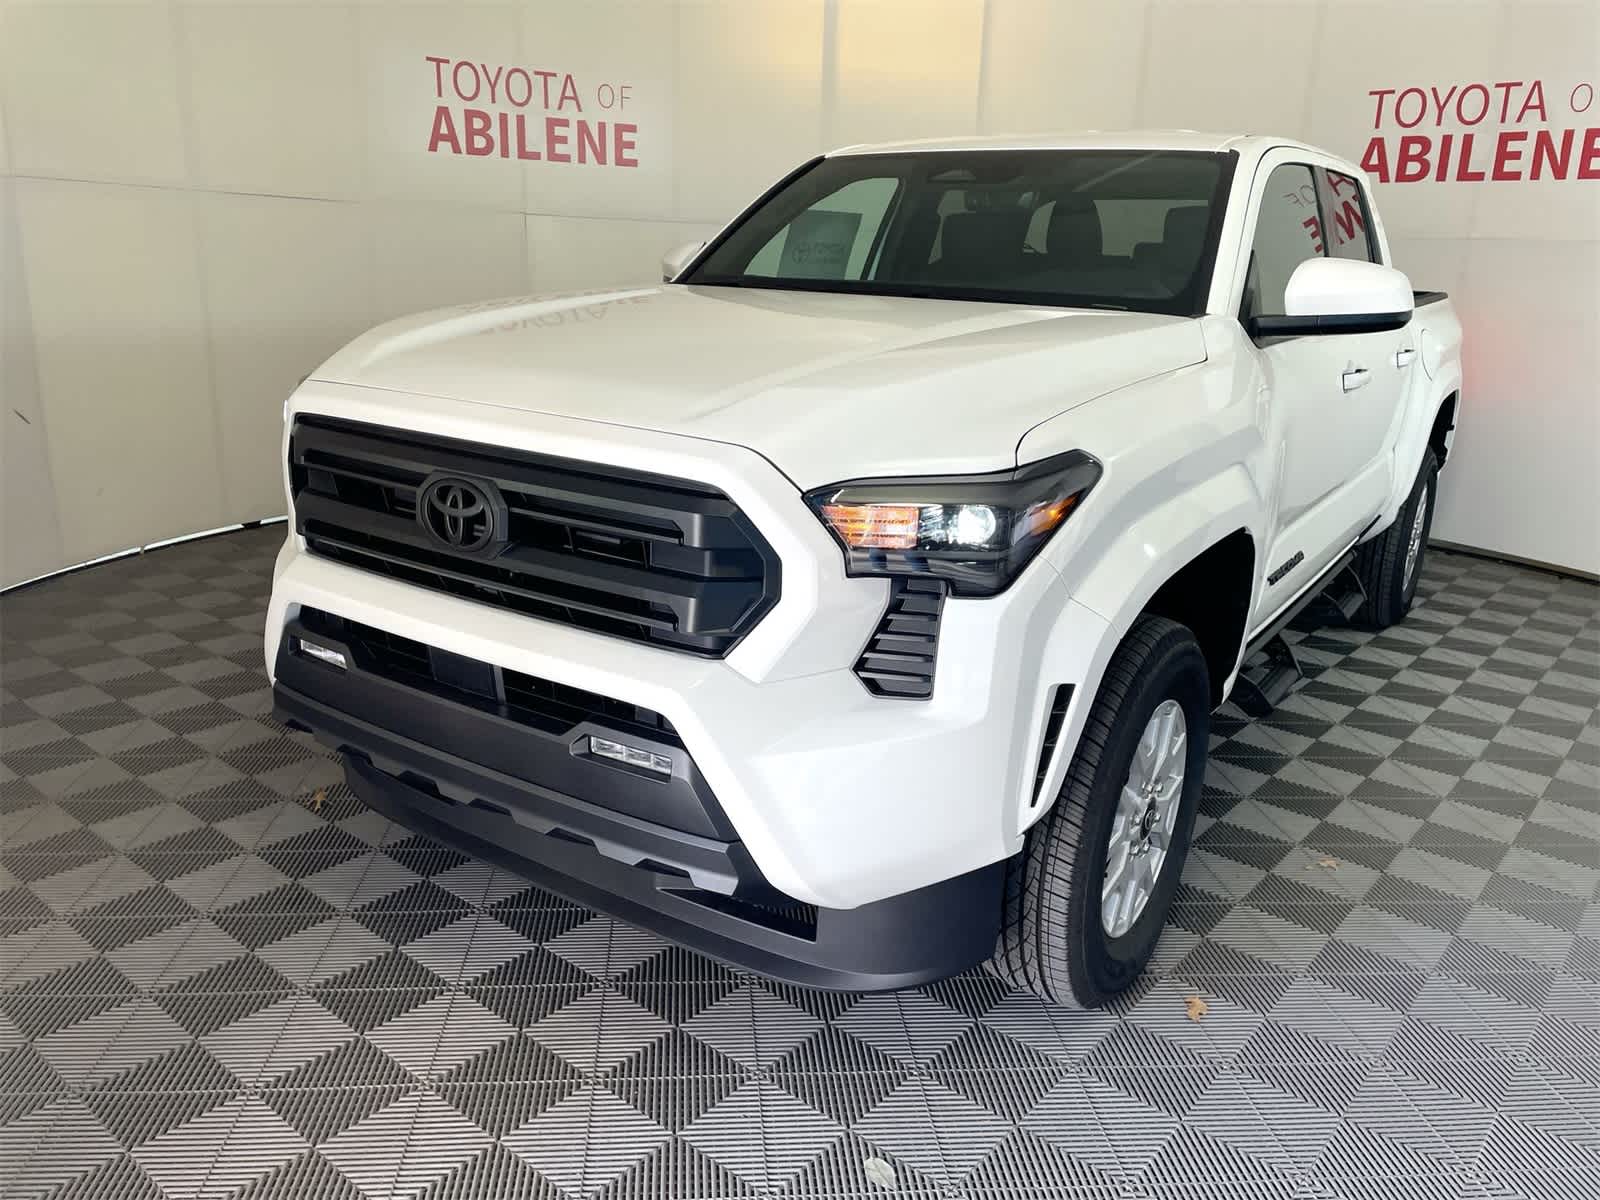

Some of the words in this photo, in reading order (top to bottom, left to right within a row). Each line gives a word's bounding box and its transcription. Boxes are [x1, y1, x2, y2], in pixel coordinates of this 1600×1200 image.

[425, 56, 583, 113] TOYOTA
[597, 83, 633, 111] OF
[1368, 80, 1548, 129] TOYOTA
[427, 105, 639, 168] ABILENE
[1360, 128, 1600, 184] ABILENE
